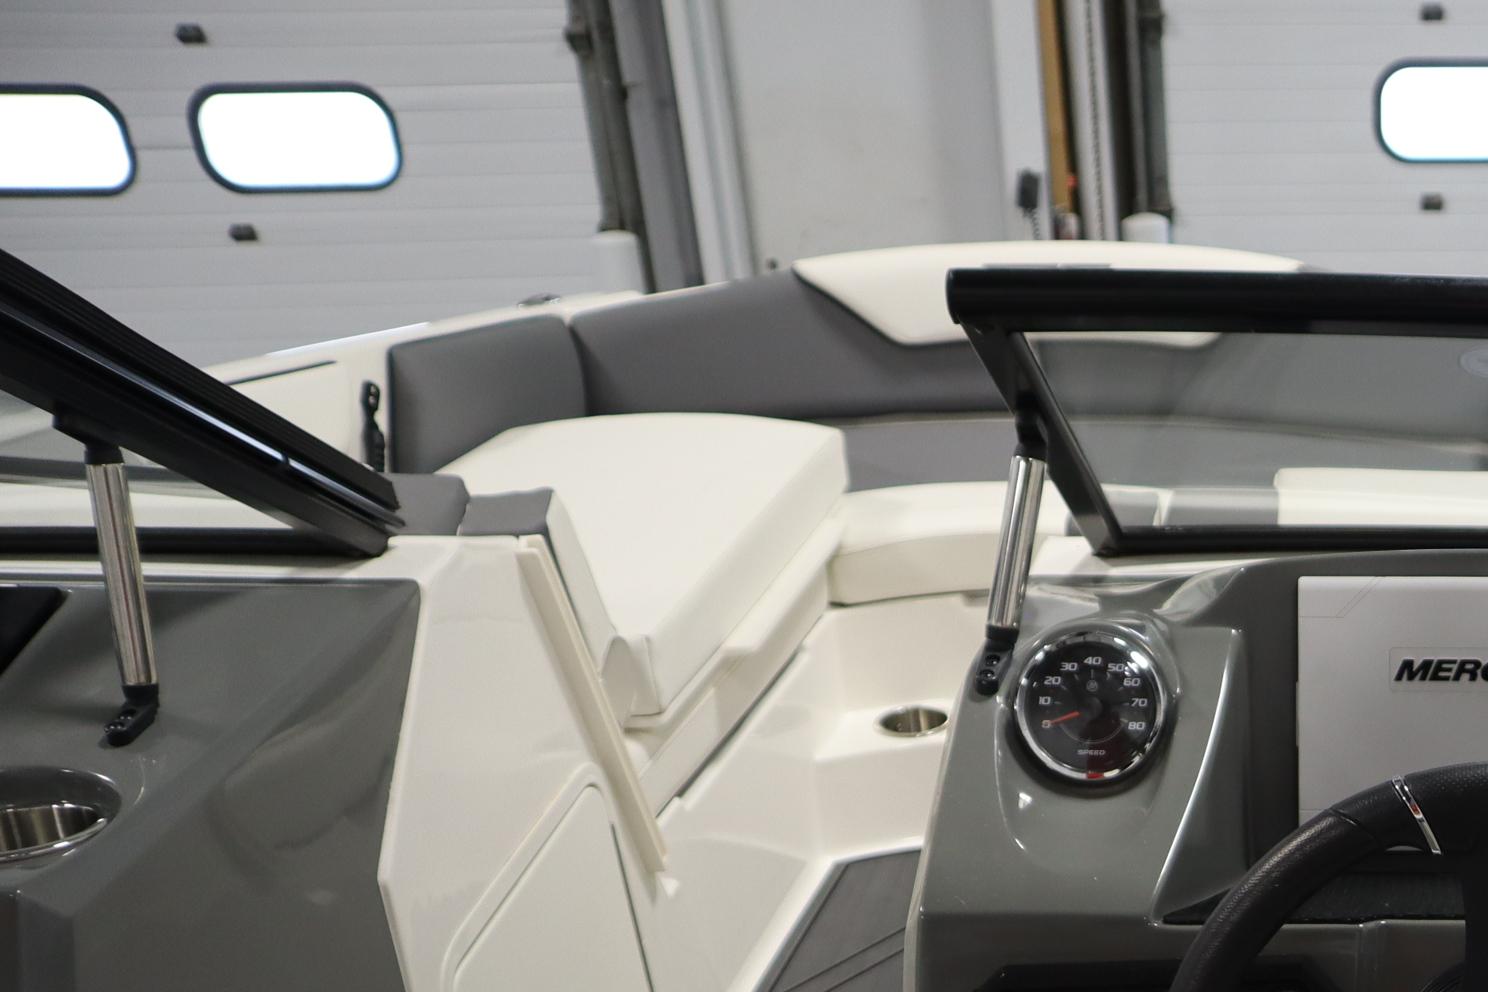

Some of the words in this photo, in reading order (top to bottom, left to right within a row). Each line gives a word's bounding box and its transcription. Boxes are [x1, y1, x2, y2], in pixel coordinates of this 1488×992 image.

[1084, 656, 1102, 665] 40
[1060, 662, 1078, 671] 30
[1107, 663, 1124, 672] 50
[1044, 676, 1061, 685] 20
[1123, 678, 1140, 687] 60
[1039, 696, 1051, 705] 10
[1131, 698, 1147, 707] 70
[1128, 721, 1145, 730] 80
